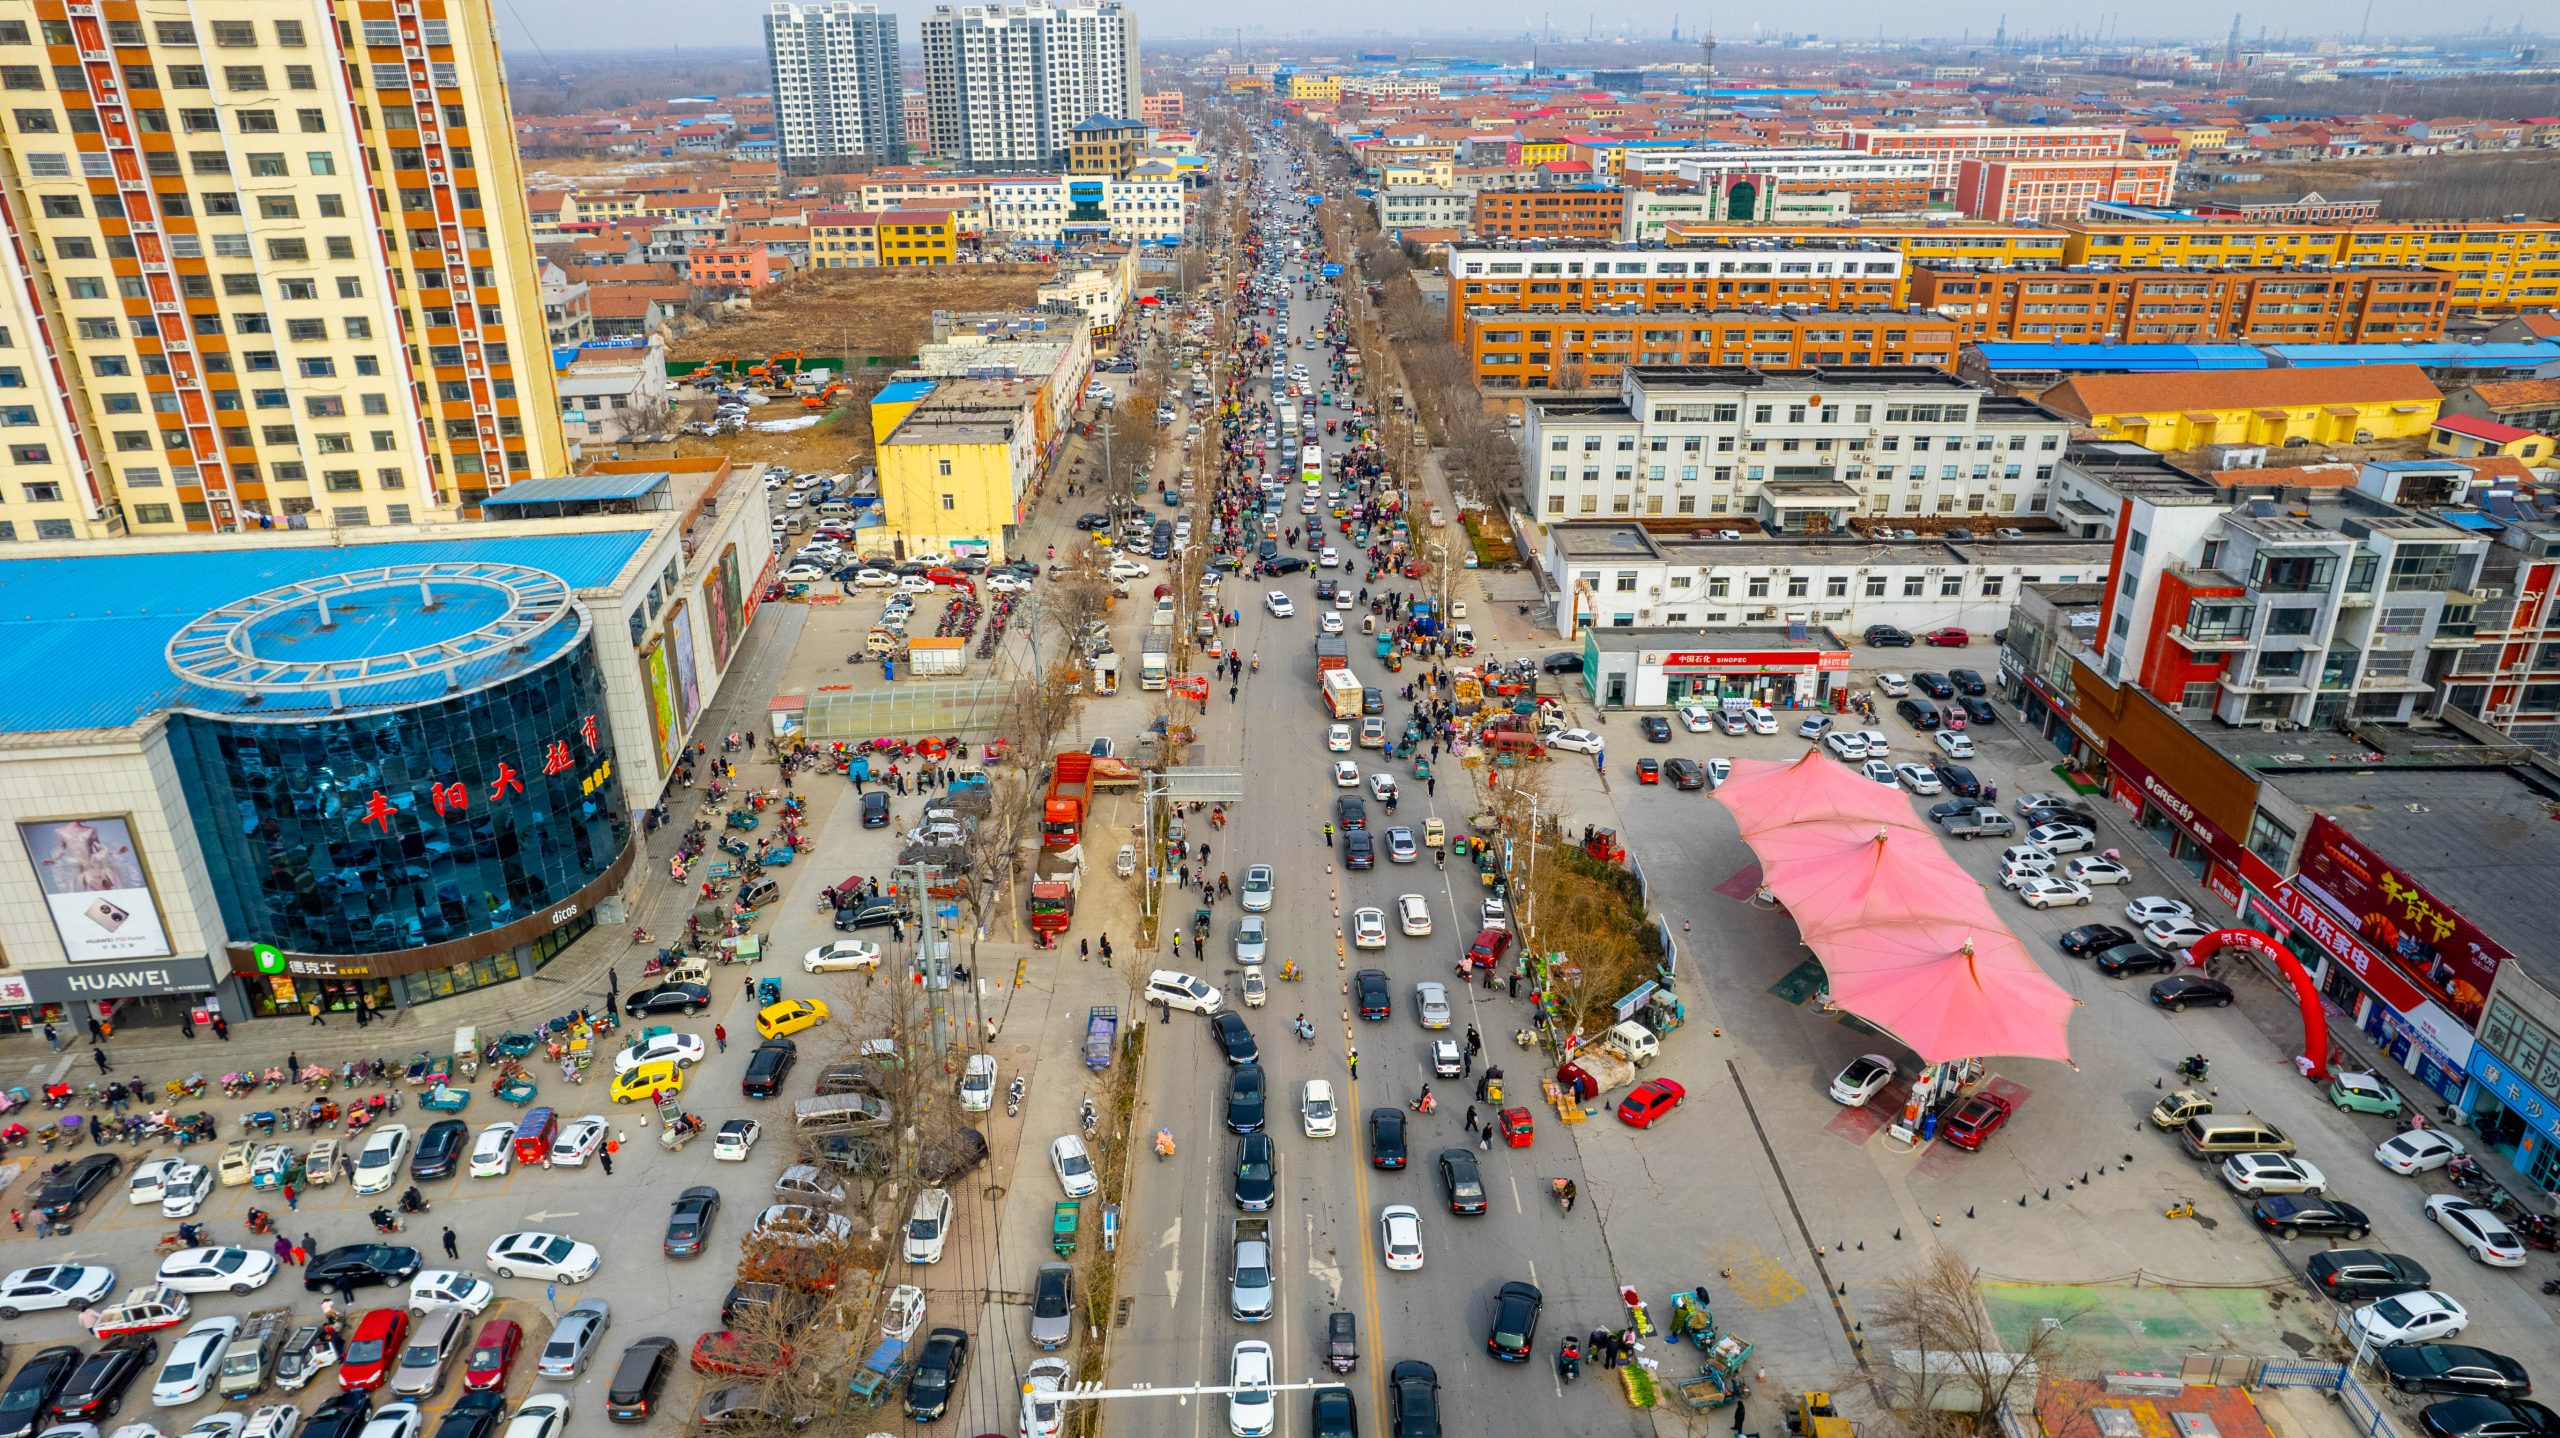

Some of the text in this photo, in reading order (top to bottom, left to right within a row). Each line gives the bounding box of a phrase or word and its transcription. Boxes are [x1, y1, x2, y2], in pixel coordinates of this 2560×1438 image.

[1678, 655, 1711, 664] 中国石化
[2152, 783, 2181, 812] GREE
[552, 904, 577, 924] dicos
[2378, 870, 2456, 943] 年货节
[2220, 931, 2278, 961] 京东家电
[2298, 902, 2370, 976] 京东家电
[67, 969, 171, 992] HUAWEI
[288, 960, 337, 975] 德克士
[2495, 1005, 2513, 1022] MOKA
[2526, 1029, 2545, 1046] MOKA
[2423, 1063, 2461, 1104] 空调
